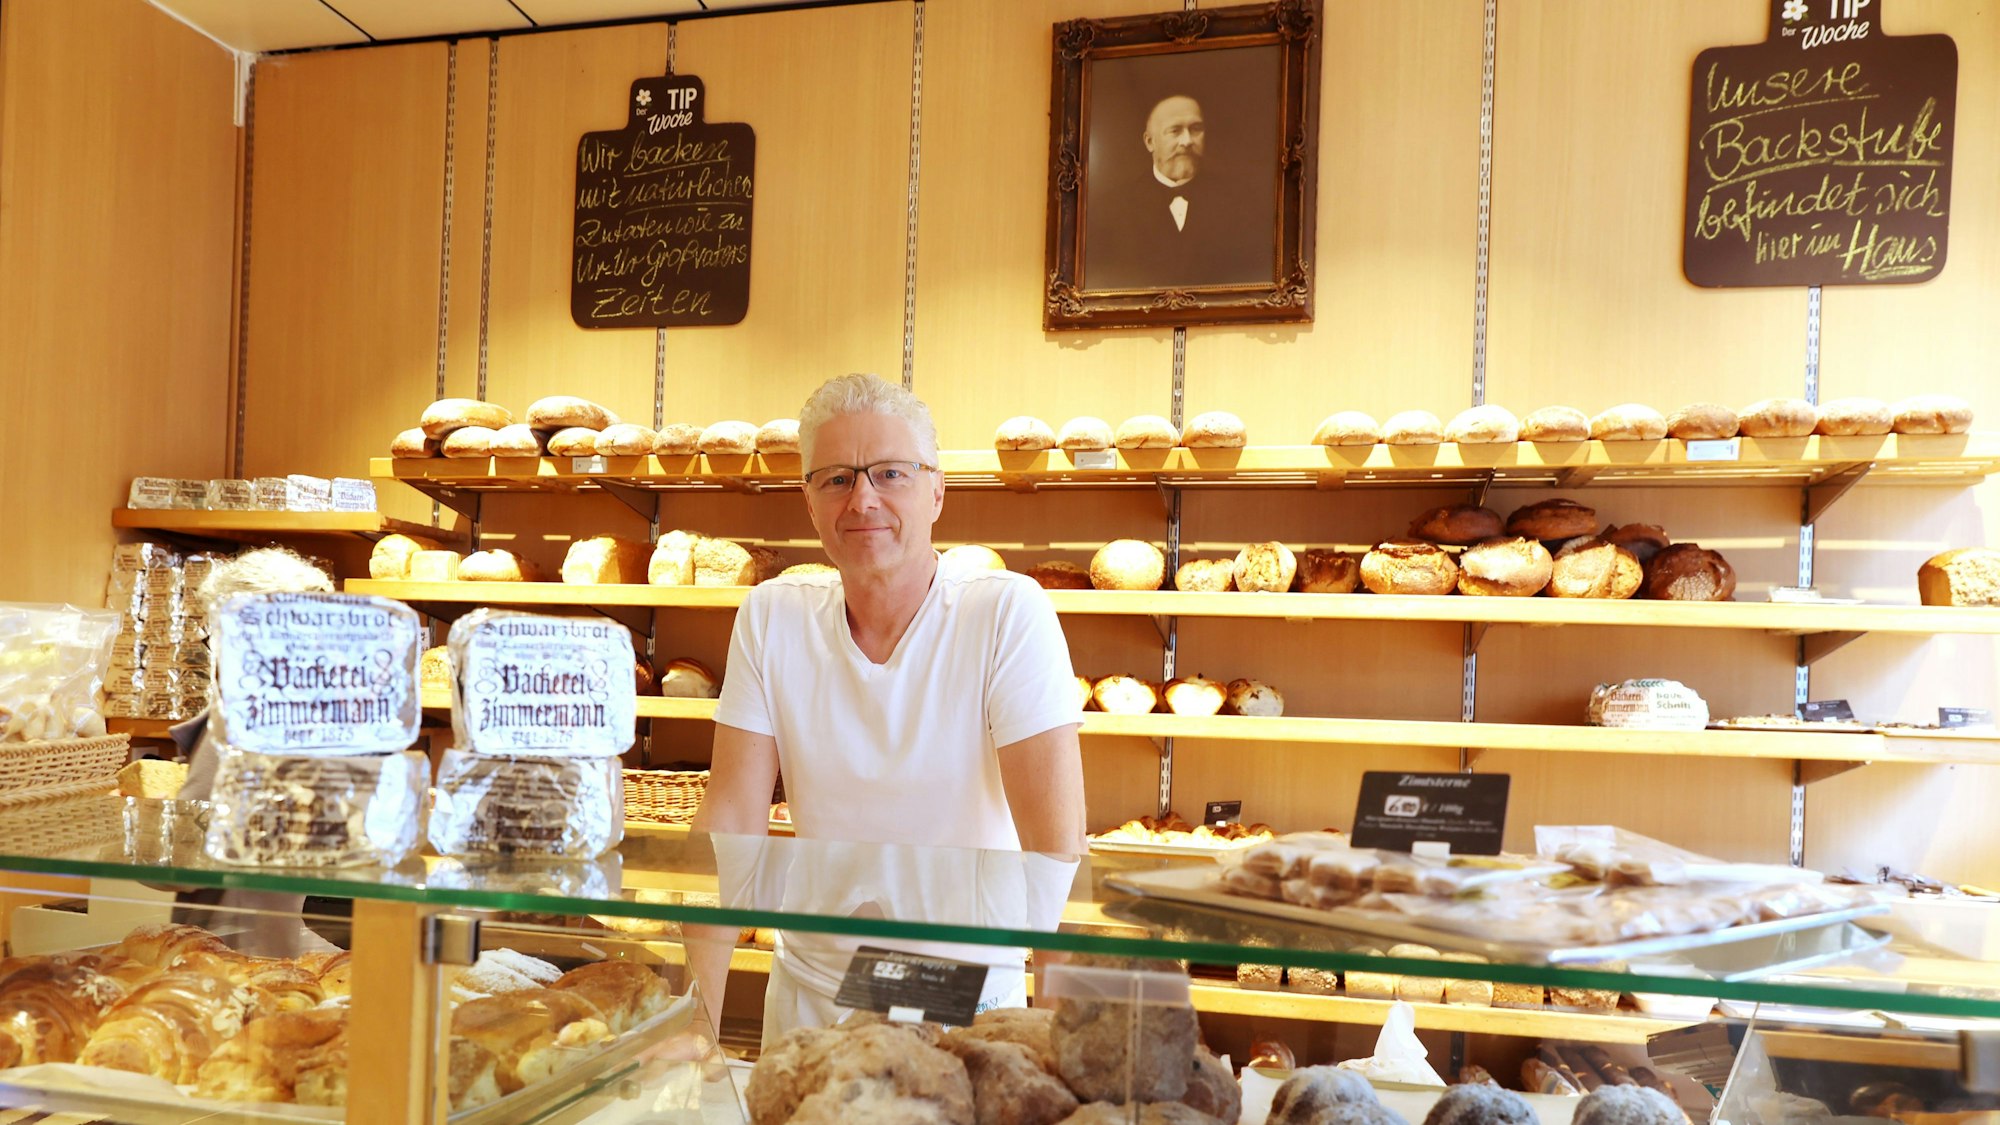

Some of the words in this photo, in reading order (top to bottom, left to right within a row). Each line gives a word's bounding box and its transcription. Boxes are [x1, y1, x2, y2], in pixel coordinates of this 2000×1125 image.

[1782, 27, 1796, 36] Der
[1801, 19, 1870, 50] Woche
[667, 88, 697, 110] TIP
[1707, 62, 1869, 112] Unsere
[636, 107, 647, 116] Der
[647, 111, 693, 135] Woche
[580, 137, 622, 173] Wir
[624, 130, 732, 172] backen
[1700, 97, 1942, 181] Backstube
[577, 178, 621, 209] mit
[625, 163, 752, 207] natürlichen
[1695, 172, 1869, 242] befindet
[1875, 169, 1945, 216] sich
[576, 210, 672, 247] Zutaten
[675, 207, 712, 233] wie
[720, 213, 744, 230] zu
[1755, 231, 1802, 264] hier
[1804, 223, 1840, 256] im
[1836, 219, 1937, 277] Haus
[591, 284, 713, 318] Zeiten
[238, 605, 395, 628] Schwarzbrot
[482, 620, 609, 640] Schwarzbrot
[262, 656, 368, 690] Bäckerei
[498, 664, 586, 694] Bäckerei
[244, 694, 392, 731] Zimmermann
[479, 697, 606, 731] Zimmermann
